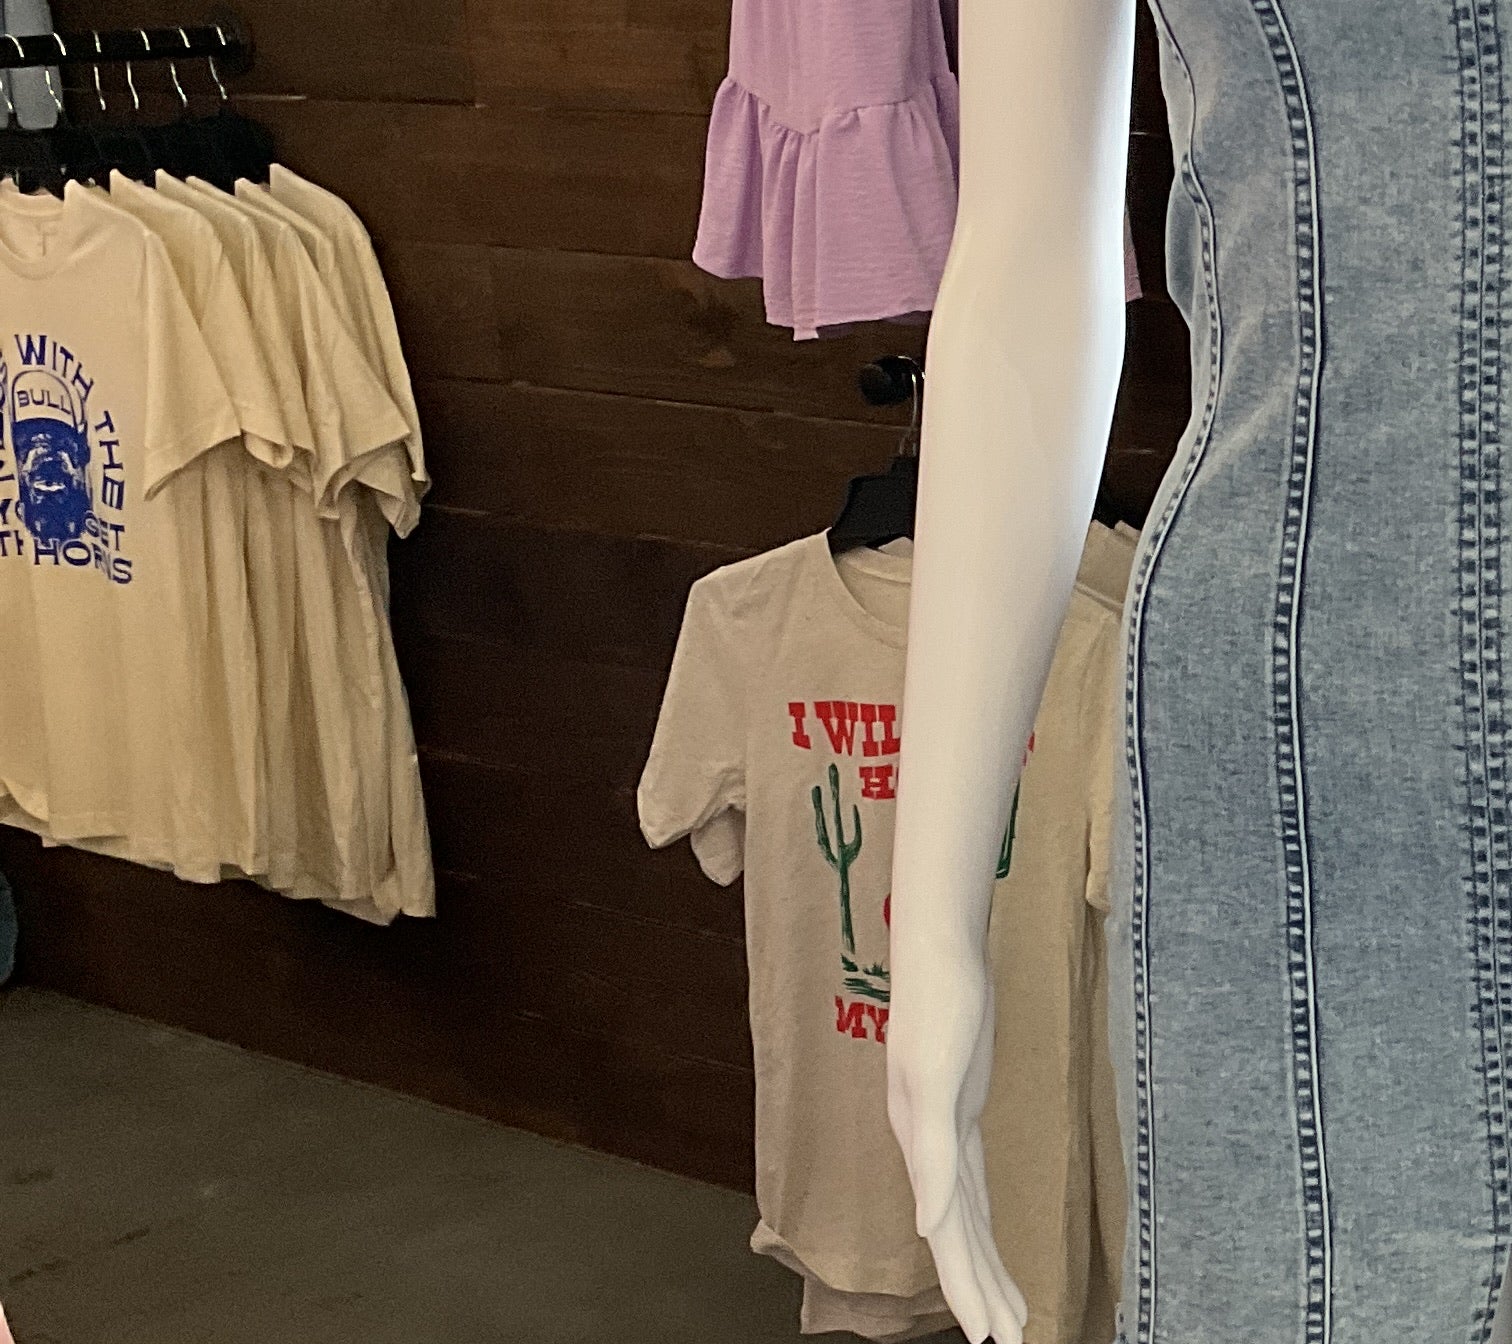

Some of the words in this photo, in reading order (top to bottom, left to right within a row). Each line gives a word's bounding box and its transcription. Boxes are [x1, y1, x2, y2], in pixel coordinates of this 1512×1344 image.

[14, 334, 94, 404] WITH
[95, 410, 125, 511] THE
[17, 388, 73, 415] BULL
[788, 701, 812, 750] I
[814, 700, 901, 757] WIL
[834, 995, 889, 1045] MY
